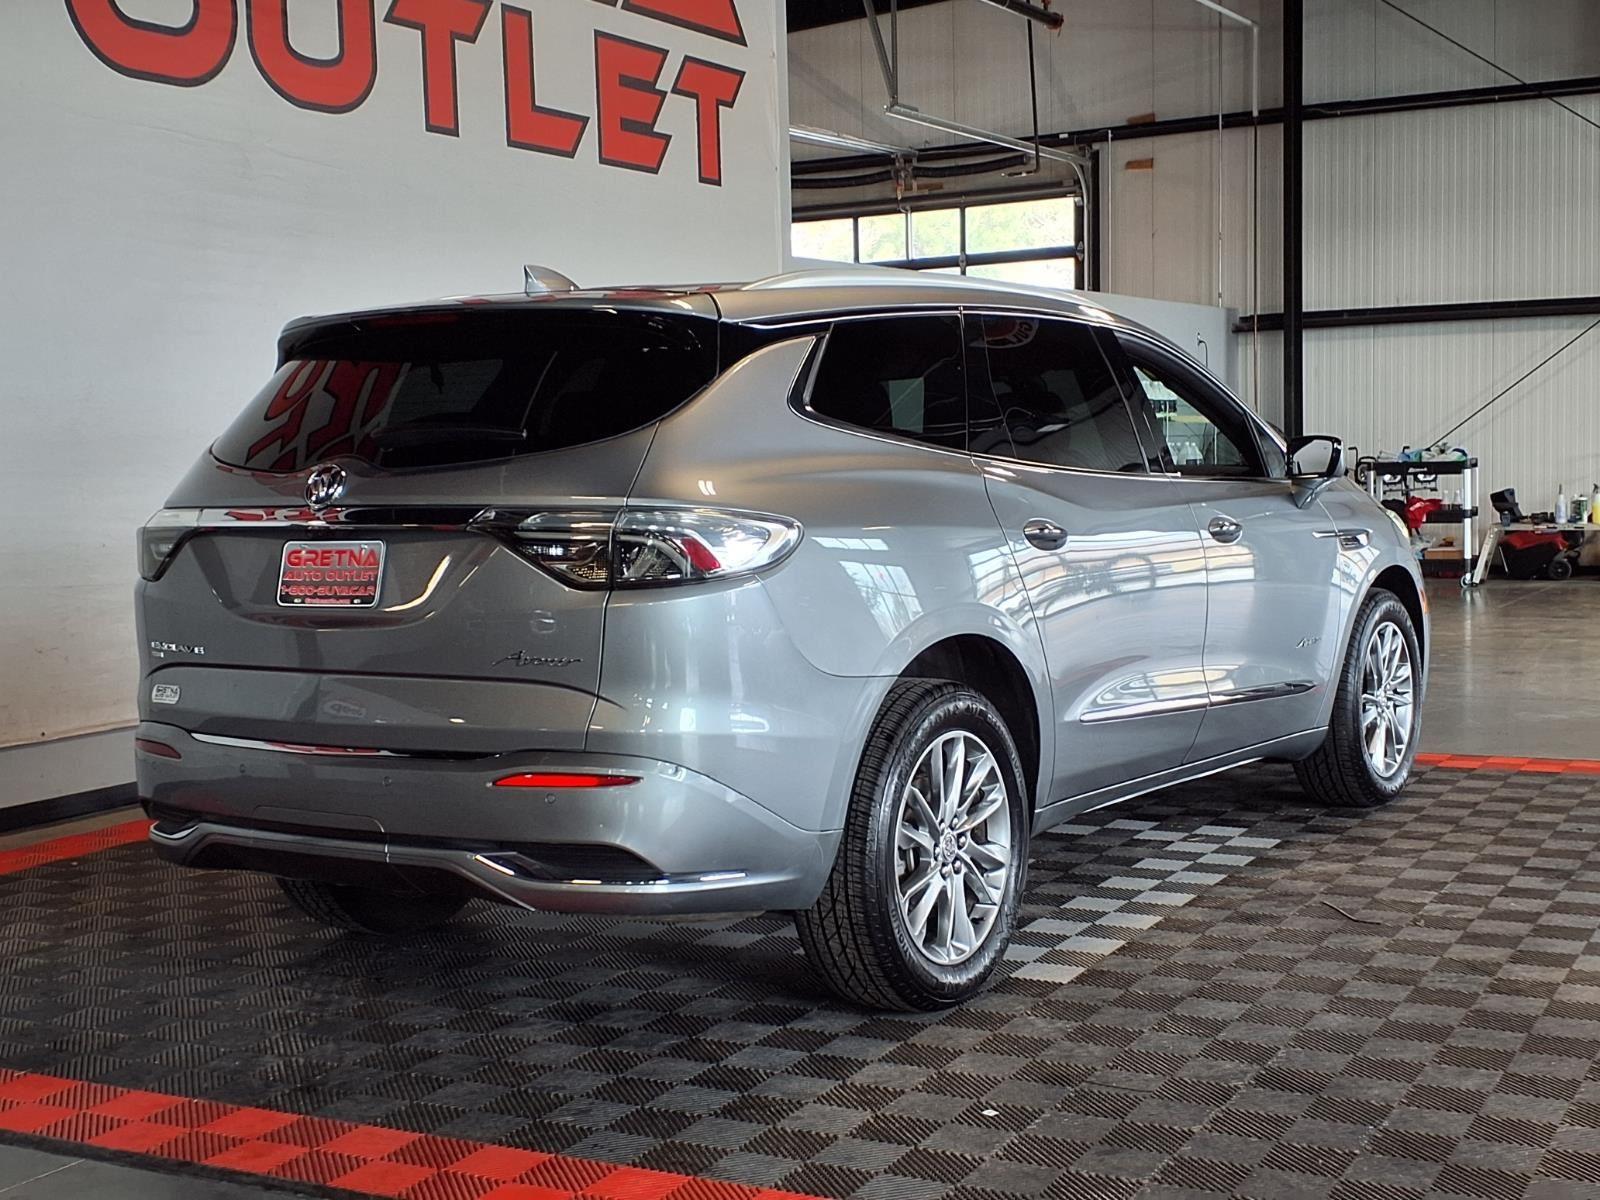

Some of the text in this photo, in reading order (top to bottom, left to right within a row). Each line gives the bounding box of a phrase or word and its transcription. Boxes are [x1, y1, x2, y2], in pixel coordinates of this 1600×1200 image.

[287, 550, 378, 568] GRETNA
[283, 571, 376, 582] AUTO OUTLET
